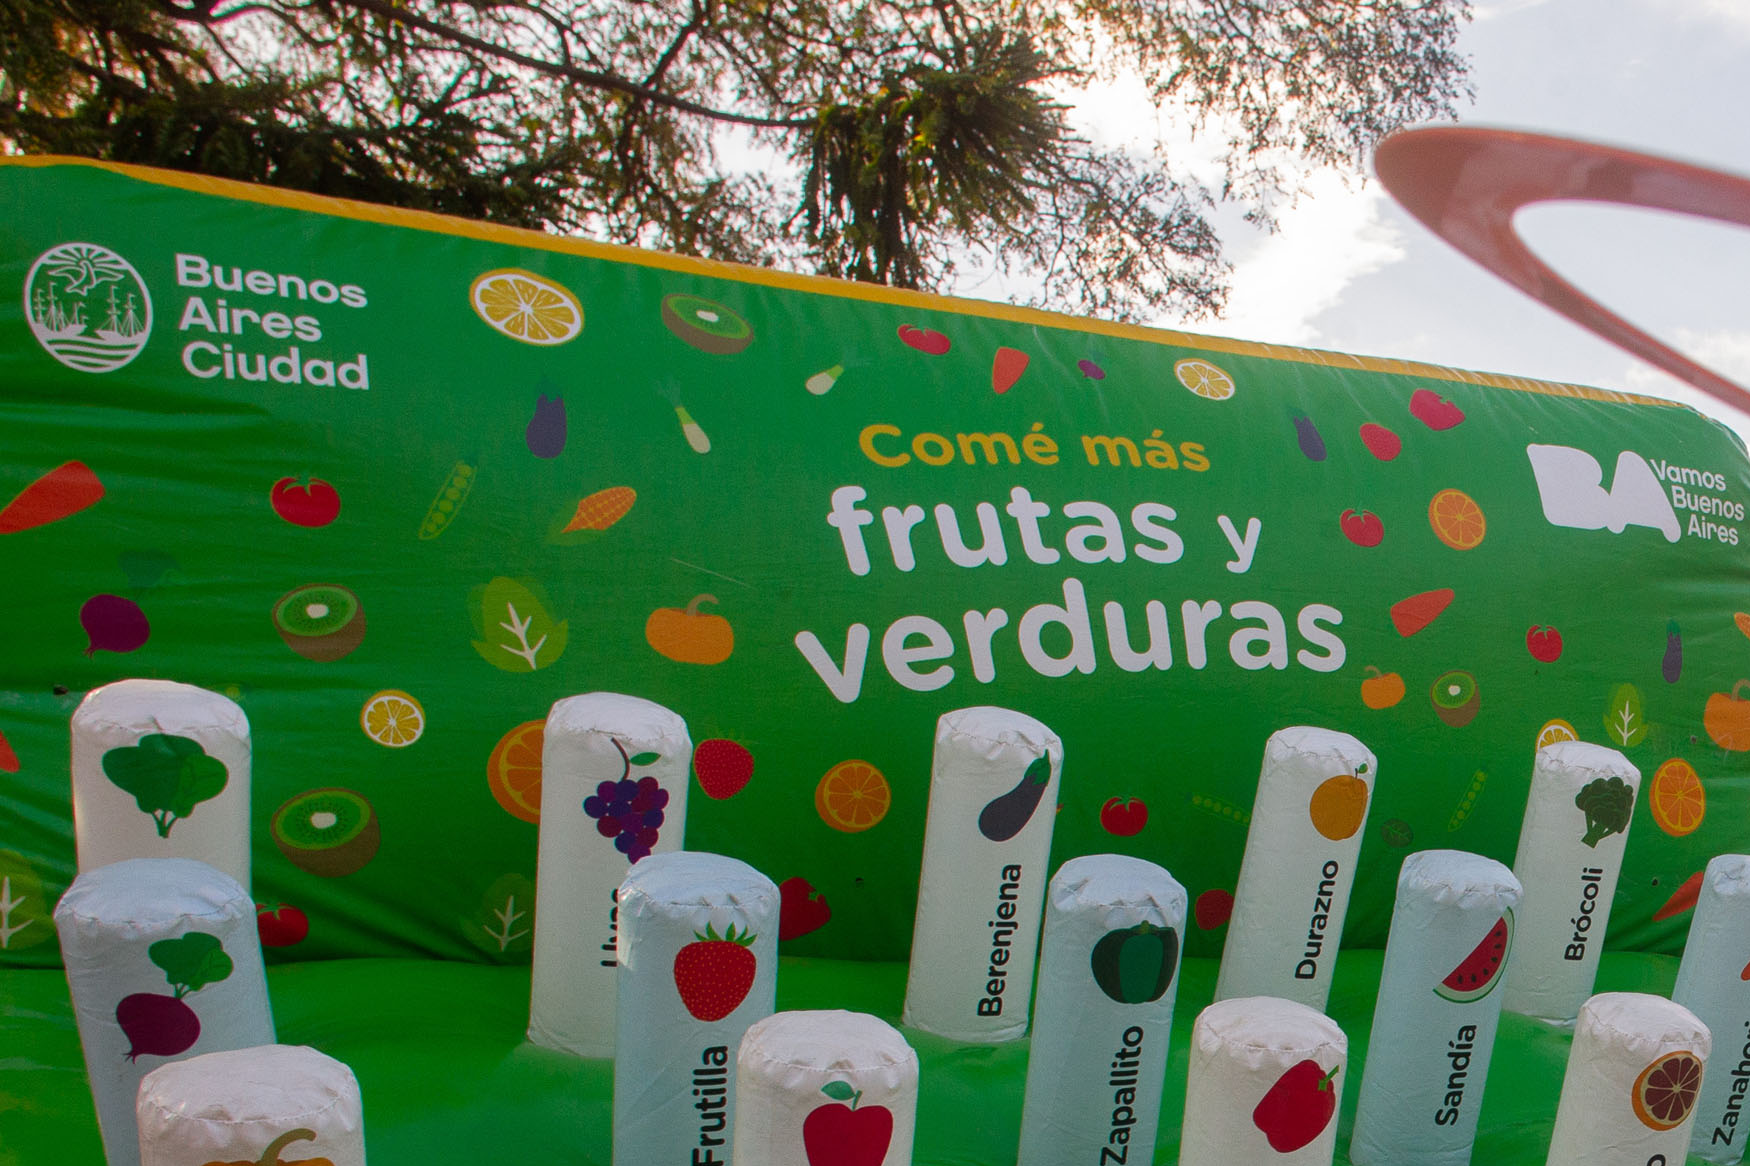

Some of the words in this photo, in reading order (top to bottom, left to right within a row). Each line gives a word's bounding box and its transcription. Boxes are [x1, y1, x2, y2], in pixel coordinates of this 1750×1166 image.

[175, 253, 368, 308] Buenos
[179, 297, 323, 343] Aires
[181, 342, 370, 390] Ciudad
[858, 422, 1060, 468] Comé
[1081, 429, 1211, 472] más
[1650, 459, 1726, 491] Vamos
[1671, 485, 1744, 521] Buenos
[1688, 514, 1738, 546] Aires
[827, 485, 1185, 577] frutas
[1217, 514, 1261, 573] y
[794, 577, 1347, 703] verduras
[978, 864, 1022, 1017] Berenjena
[1295, 861, 1339, 979] Durazno
[1564, 867, 1603, 961] Brócoli
[1435, 1024, 1477, 1126] Sandía
